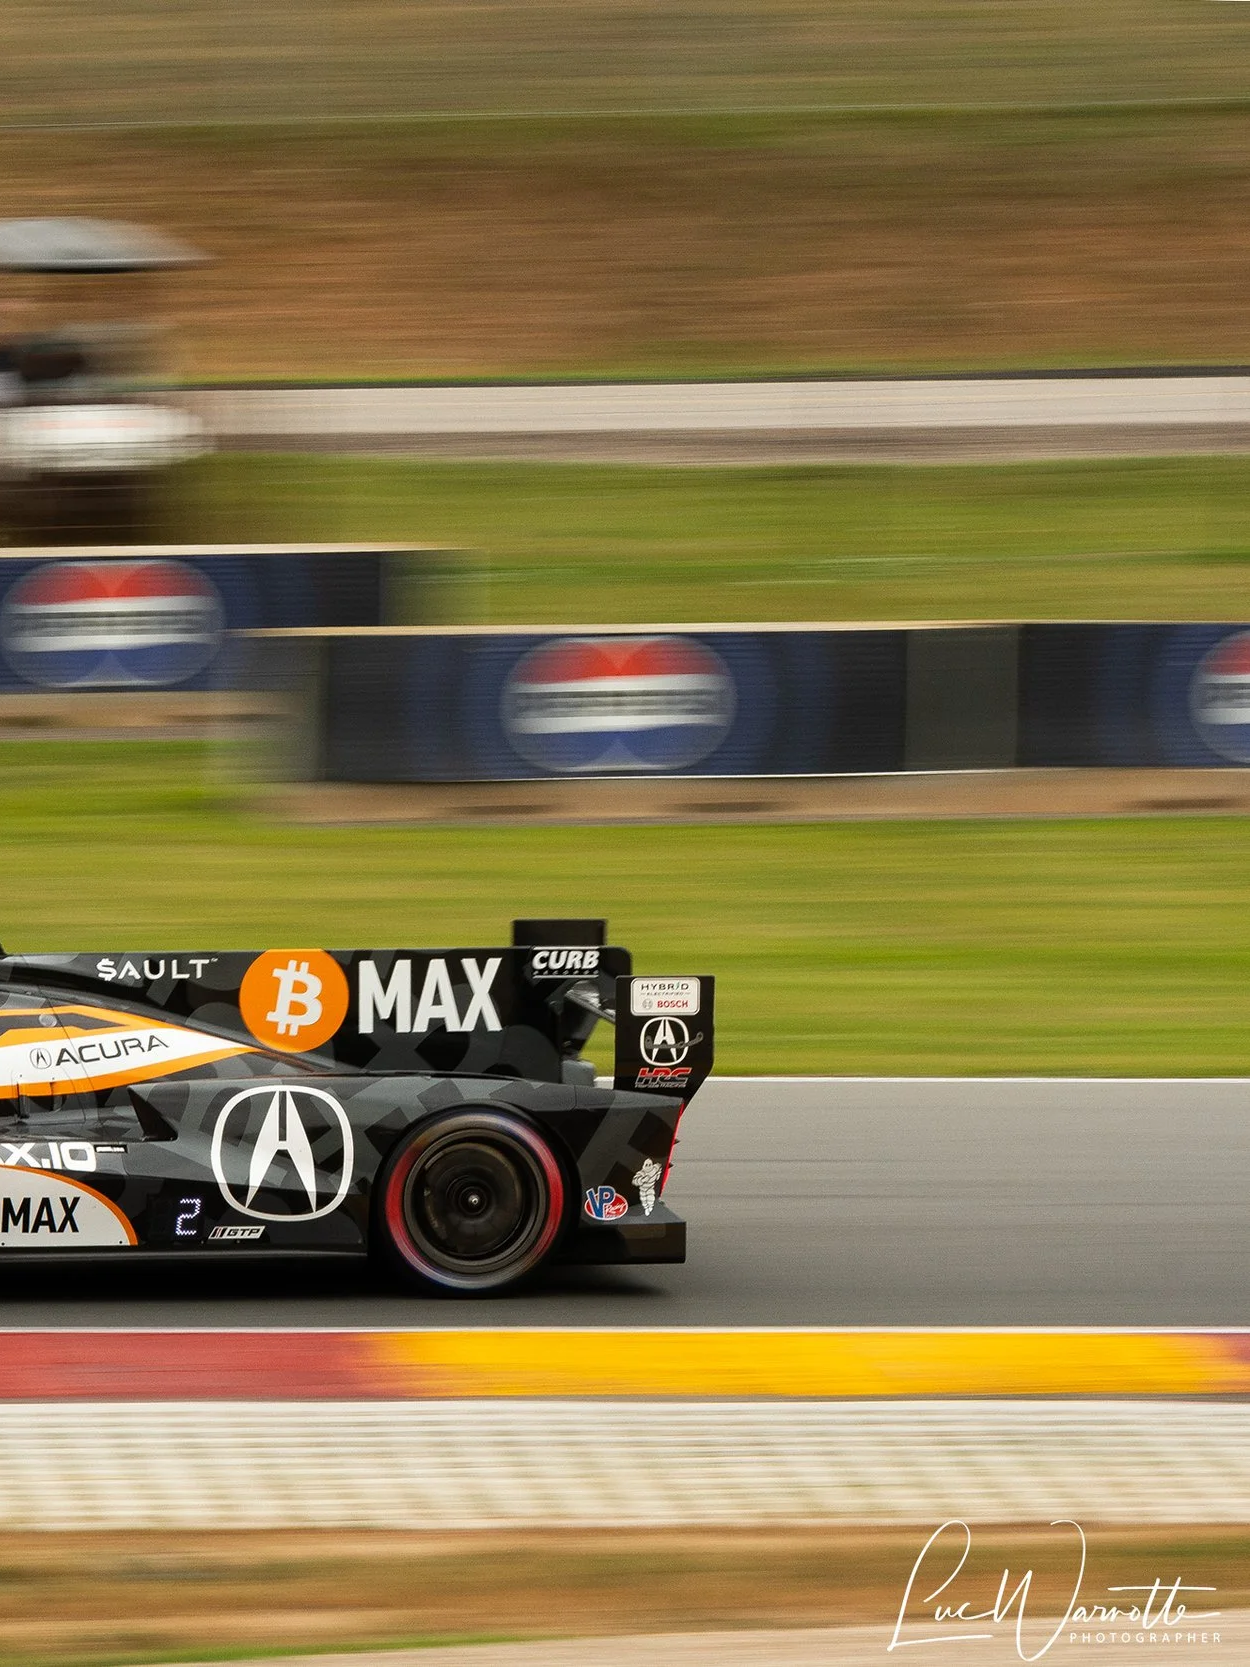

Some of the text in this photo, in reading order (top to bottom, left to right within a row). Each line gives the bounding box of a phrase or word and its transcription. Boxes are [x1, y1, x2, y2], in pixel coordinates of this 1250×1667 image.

[532, 950, 600, 969] CURB
[358, 957, 503, 1034] MAX
[641, 981, 689, 990] HYBRID
[657, 1000, 688, 1008] BOSCH
[55, 1034, 169, 1066] ACURA
[634, 1067, 692, 1084] HRC
[0, 1196, 81, 1233] MAX
[586, 1186, 615, 1219] VP
[175, 1198, 202, 1236] 2
[226, 1228, 260, 1237] GTP
